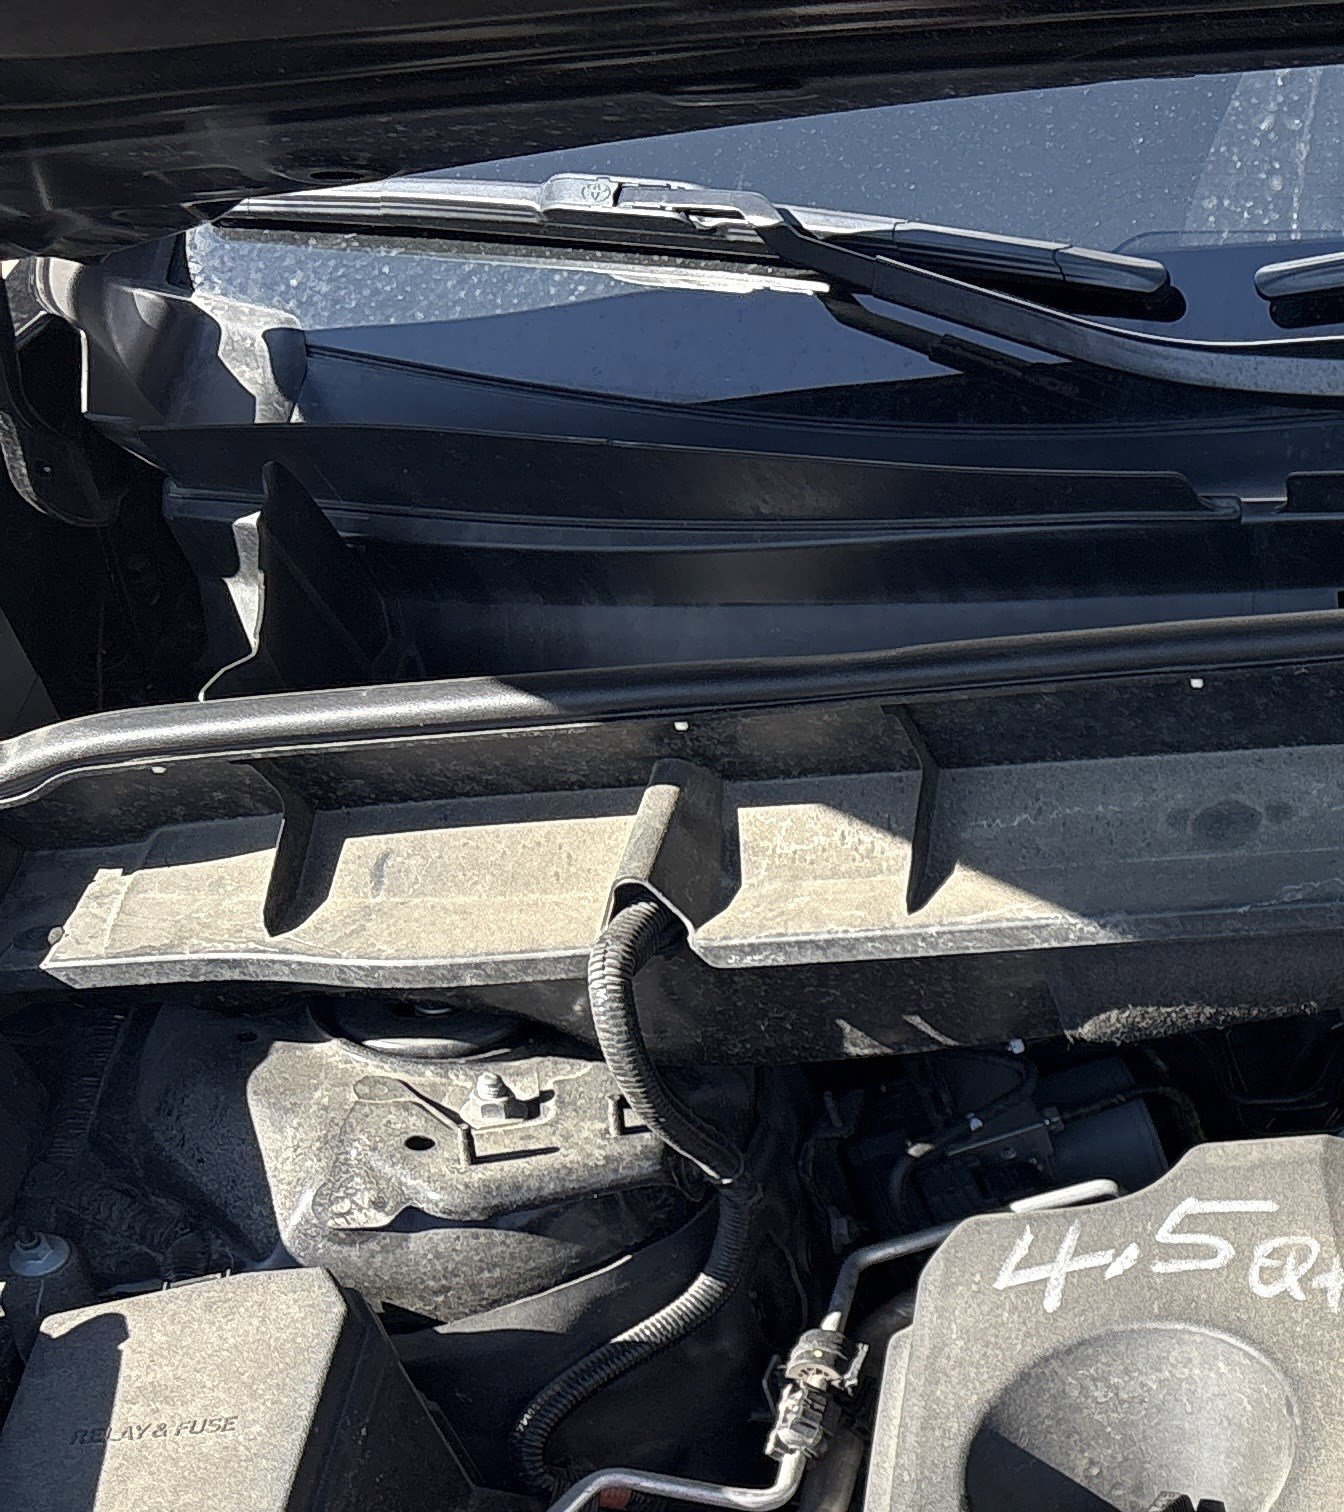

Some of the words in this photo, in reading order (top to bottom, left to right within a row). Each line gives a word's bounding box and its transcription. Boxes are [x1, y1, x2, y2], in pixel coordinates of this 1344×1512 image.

[69, 1422, 151, 1444] RELAY
[152, 1422, 168, 1439] &
[174, 1416, 239, 1437] FUSE
